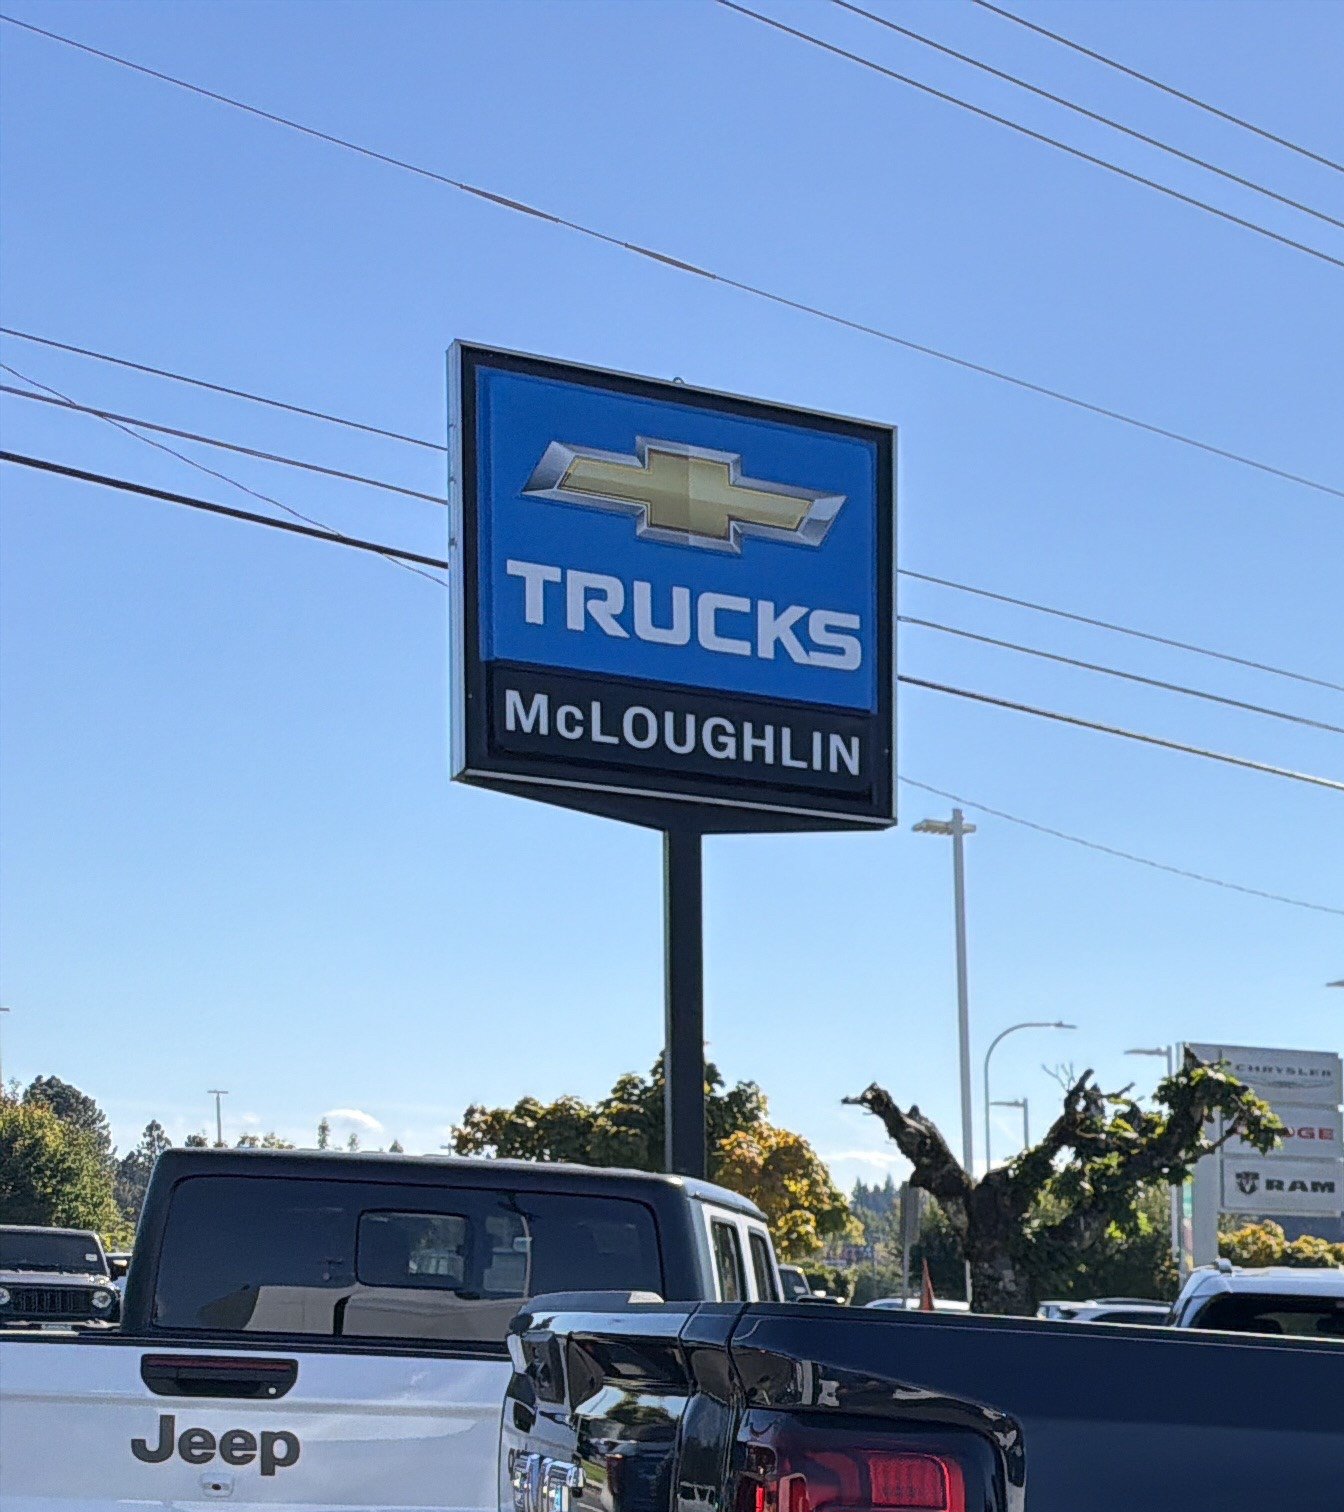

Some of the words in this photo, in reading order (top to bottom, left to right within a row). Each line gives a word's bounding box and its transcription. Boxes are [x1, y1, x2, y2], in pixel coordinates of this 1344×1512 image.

[507, 559, 861, 671] TRUCKS
[505, 689, 860, 776] McLOUGHLIN
[1235, 1063, 1332, 1077] CHRYSLER
[1265, 1178, 1335, 1194] RAM
[131, 1415, 300, 1476] Jeep
